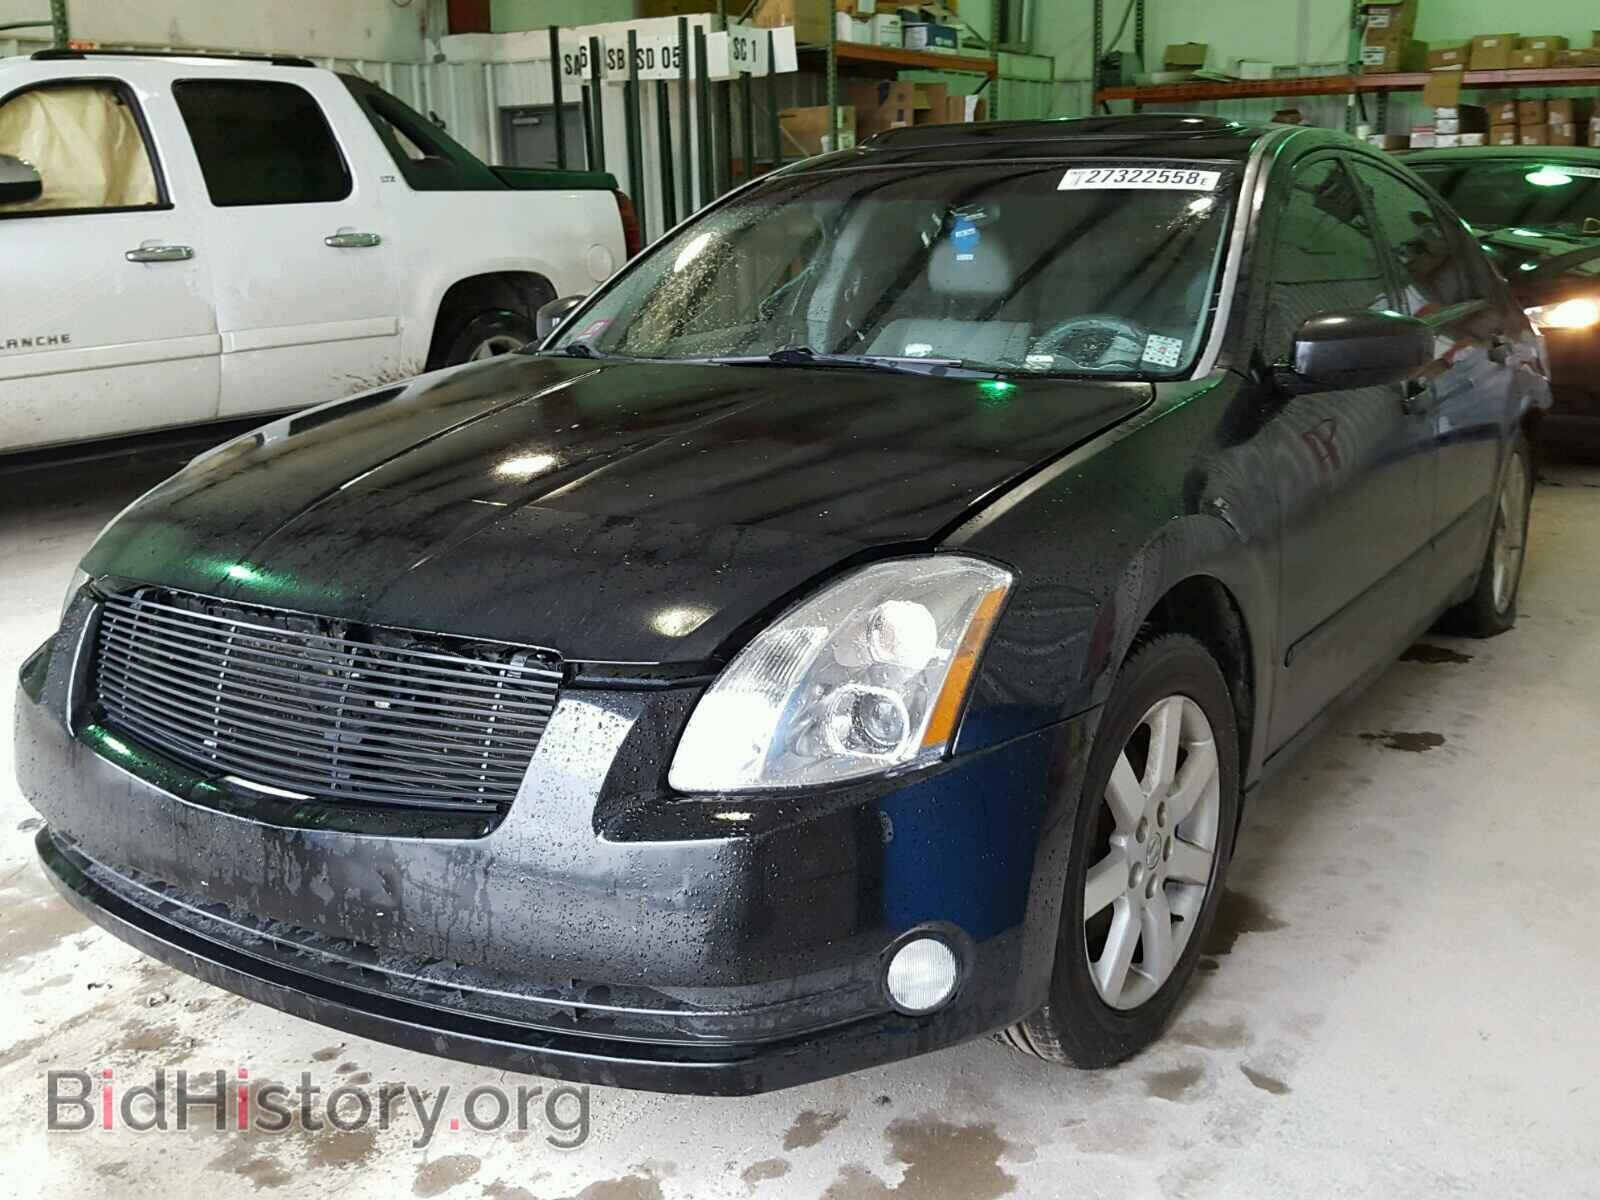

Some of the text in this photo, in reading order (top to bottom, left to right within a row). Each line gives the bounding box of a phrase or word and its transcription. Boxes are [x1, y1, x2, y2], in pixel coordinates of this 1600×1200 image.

[607, 48, 625, 70] SB
[636, 46, 680, 70] SD 05
[733, 36, 748, 61] SC
